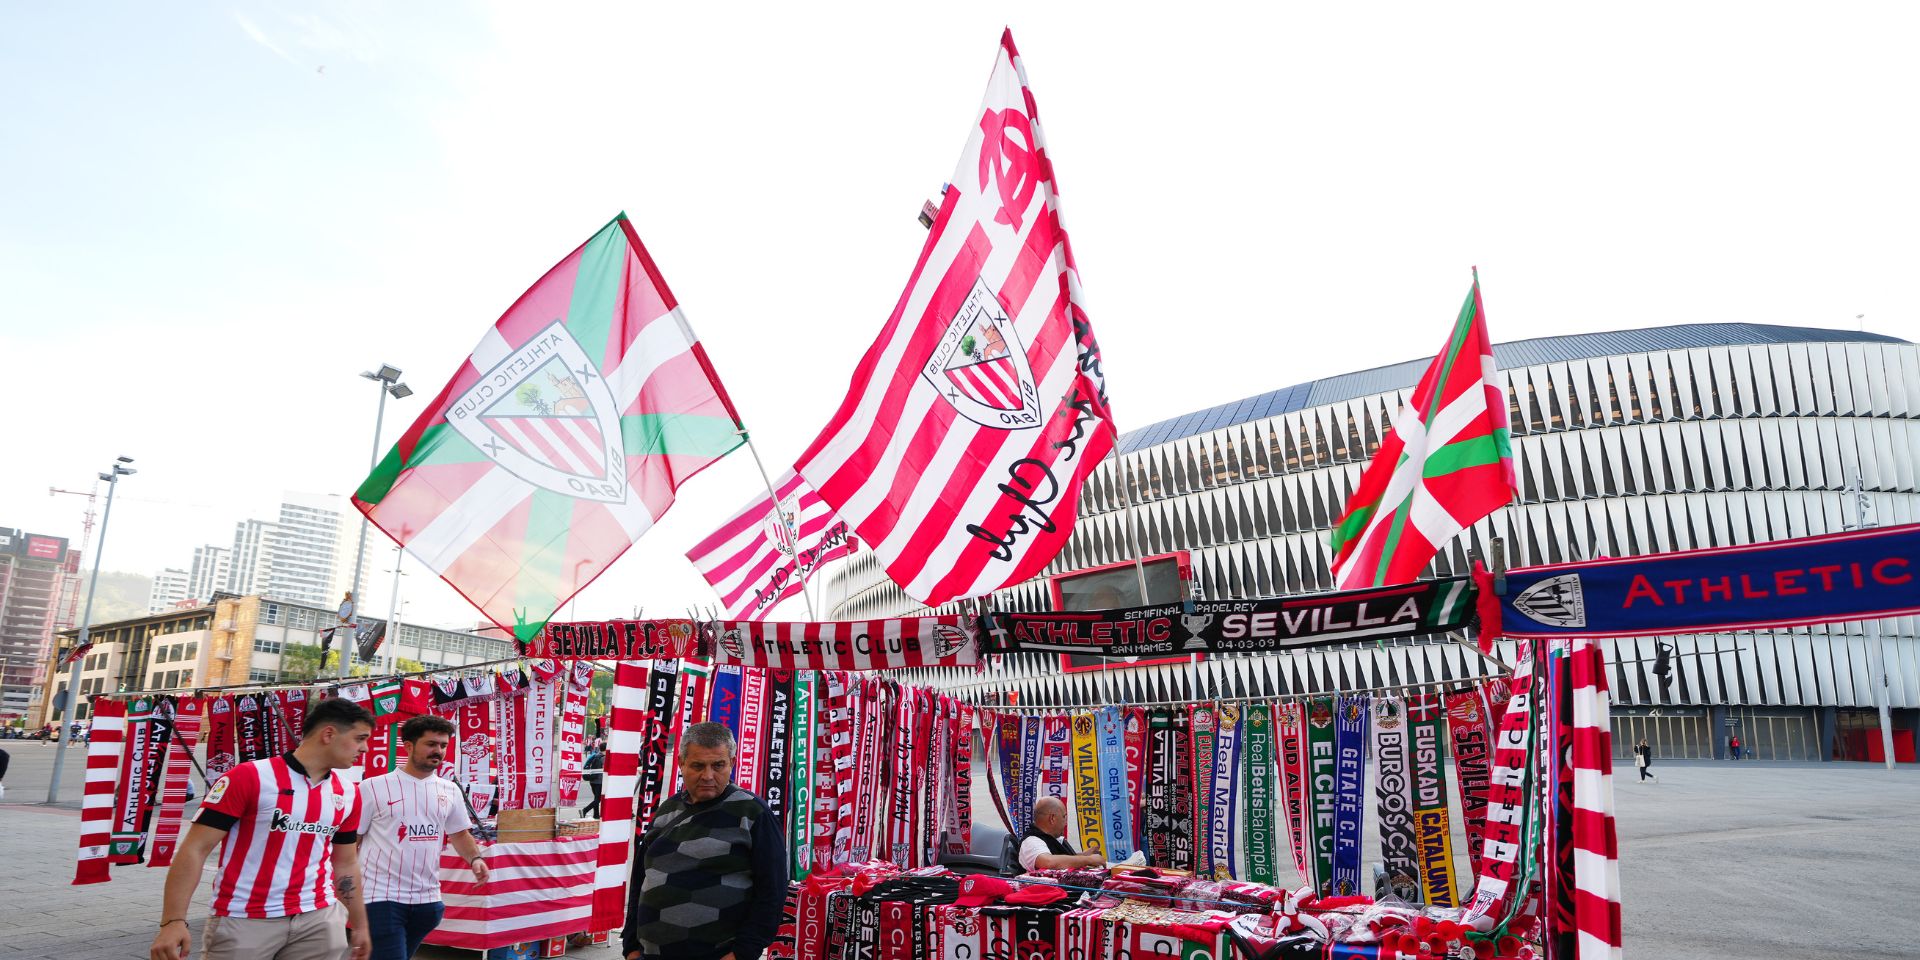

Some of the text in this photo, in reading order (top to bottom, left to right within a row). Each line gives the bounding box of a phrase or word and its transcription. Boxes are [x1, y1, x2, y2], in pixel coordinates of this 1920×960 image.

[1124, 608, 1181, 620] SEMIFINAL
[1212, 603, 1232, 612] DEL
[1234, 602, 1258, 612] REY
[1622, 557, 1912, 609] ATHLETIC
[553, 625, 620, 657] SEVILLA
[753, 634, 847, 656] ATHLETIC
[855, 633, 920, 655] CLUB
[1014, 617, 1172, 646] ATHLETIC
[1111, 642, 1173, 654] SAN MAMES
[1221, 597, 1420, 637] SEVILLA
[683, 686, 694, 724] LUB
[740, 675, 761, 784] UNIQUE IN THE
[769, 690, 787, 780] ATHLETIC
[640, 678, 668, 835] HLETIC CLUB
[797, 687, 810, 840] ATHLETIC CLUB
[1024, 738, 1036, 790] ESPANYOL
[1106, 735, 1117, 746] 19
[1153, 730, 1164, 810] SEVILLA
[1176, 730, 1189, 814] ATHLETIC
[1284, 738, 1299, 766] UD
[1415, 725, 1440, 807] EUSKADI
[1456, 730, 1490, 811] SEVILLA
[124, 727, 147, 826] ATHLETIC CLUB
[858, 713, 876, 835] ATHLETIC CLUB
[893, 726, 915, 822] Athletic Club
[1024, 792, 1032, 803] de
[1078, 743, 1099, 836] VILLARREAL
[1108, 767, 1120, 801] CELTA
[1213, 735, 1232, 860] Real Madrid
[1313, 741, 1335, 829] ELCHE
[1338, 747, 1358, 850] GETAFE C.F.
[1378, 732, 1406, 827] BURGOS
[1490, 678, 1528, 880] ATHLETIC CLUB
[409, 824, 438, 836] NAGA
[1112, 809, 1124, 840] VIGO
[1115, 849, 1127, 861] 23
[915, 930, 921, 941] ES
